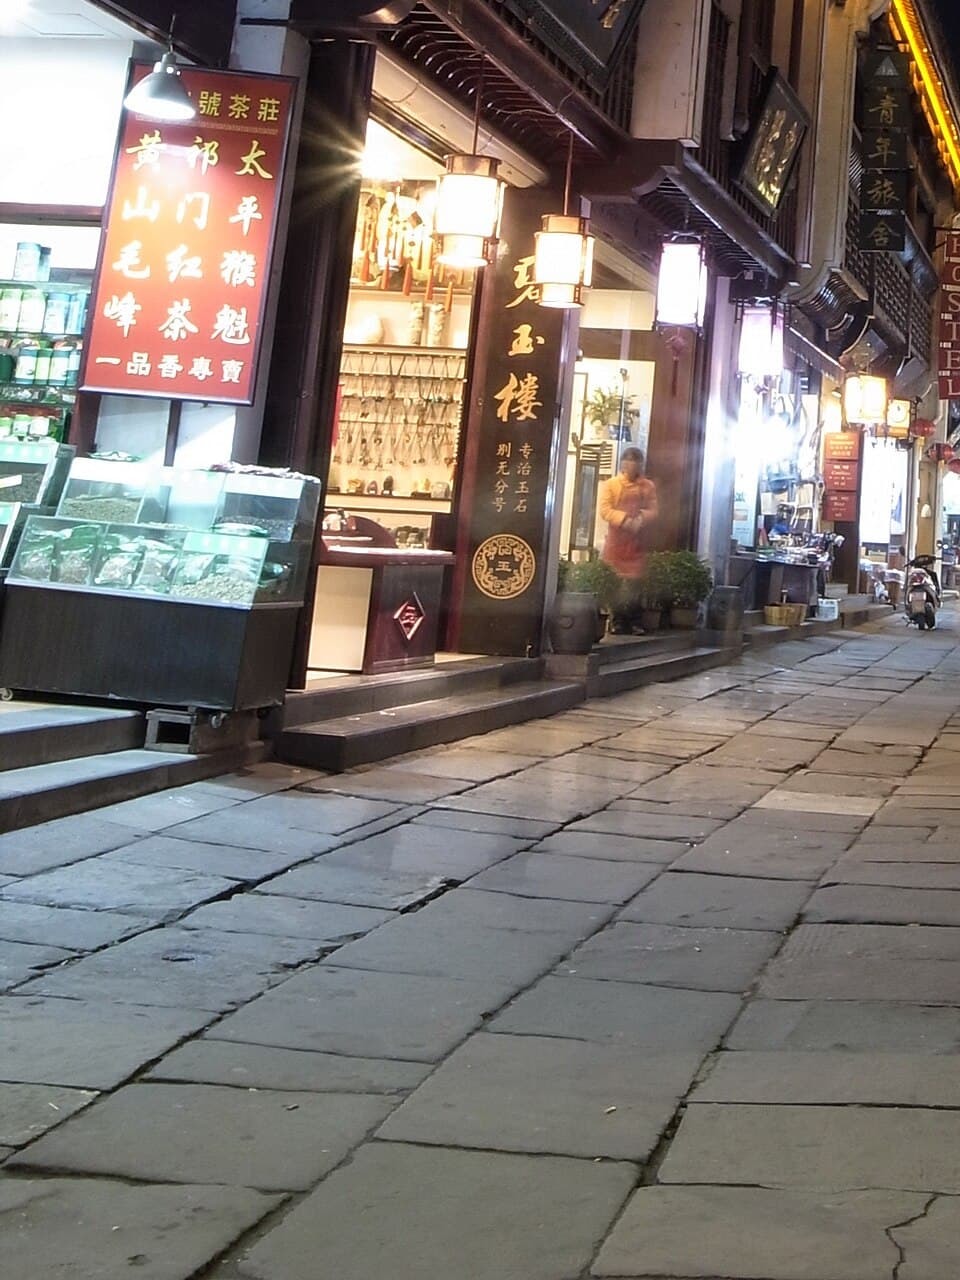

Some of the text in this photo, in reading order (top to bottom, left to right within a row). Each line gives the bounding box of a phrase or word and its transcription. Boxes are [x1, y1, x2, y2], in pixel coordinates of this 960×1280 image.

[188, 90, 281, 122] 號茶莊
[866, 95, 900, 248] 青年旅舍
[103, 129, 167, 339] 黄山毛峰
[158, 136, 220, 341] 祁门红茶
[210, 140, 273, 345] 太平猴魁
[95, 351, 245, 384] 一品香專賣
[491, 441, 512, 513] 别无分号
[513, 442, 534, 513] 专治玉石
